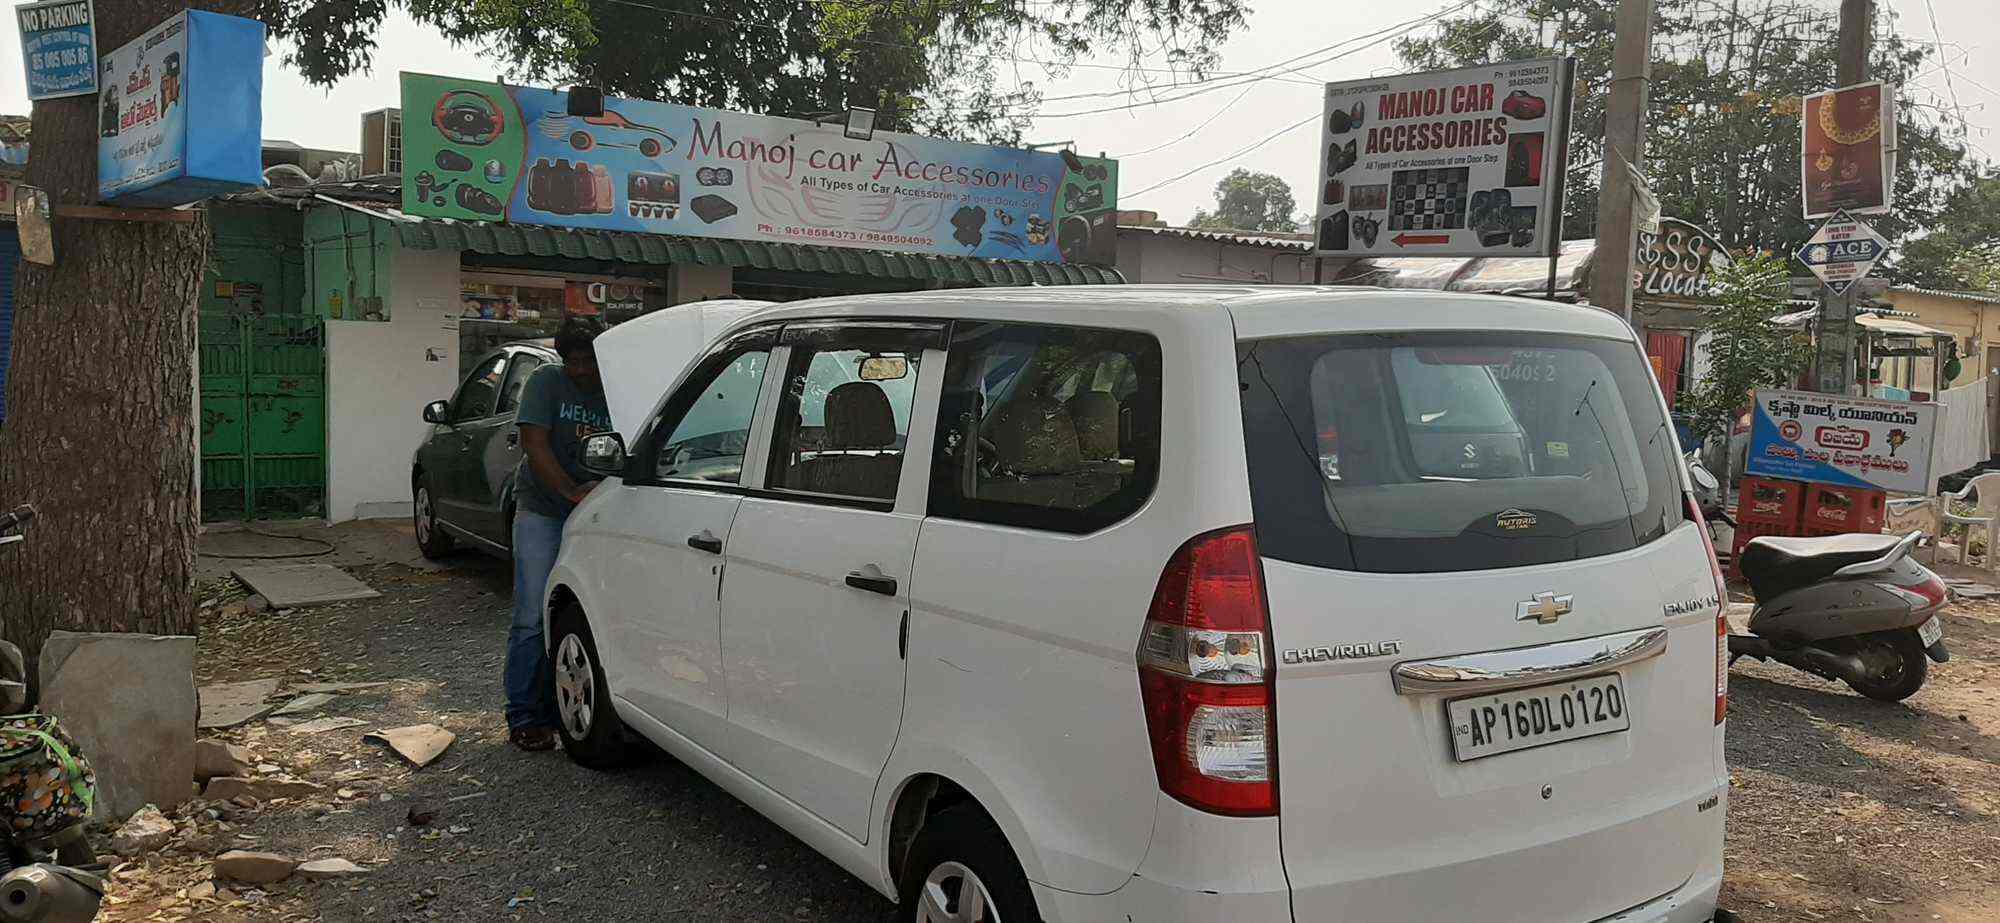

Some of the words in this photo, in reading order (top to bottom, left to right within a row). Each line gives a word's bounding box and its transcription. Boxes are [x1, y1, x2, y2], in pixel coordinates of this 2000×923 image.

[21, 9, 39, 32] NO
[40, 3, 88, 30] PARKING
[1378, 90, 1448, 121] MANOJ
[1450, 83, 1495, 114] CAR
[1365, 116, 1508, 154] ACCESSORIES
[685, 118, 796, 180] Manoj
[809, 149, 863, 173] car
[872, 142, 1050, 193] Accessories
[1398, 159, 1409, 168] Car
[1410, 157, 1445, 167] Accessories
[1467, 154, 1482, 163] Door
[800, 176, 817, 187] All
[819, 177, 854, 192] Types
[857, 182, 868, 192] of
[871, 183, 889, 195] Car
[893, 185, 958, 201] Accessories
[757, 223, 773, 233] Ph
[784, 226, 857, 241] 9618584373
[1833, 240, 1872, 256] ACE
[1663, 598, 1704, 617] ENJOY
[1283, 639, 1402, 665] CHEVROLET
[1455, 724, 1469, 737] IND
[1470, 684, 1623, 747] AP16DL0120
